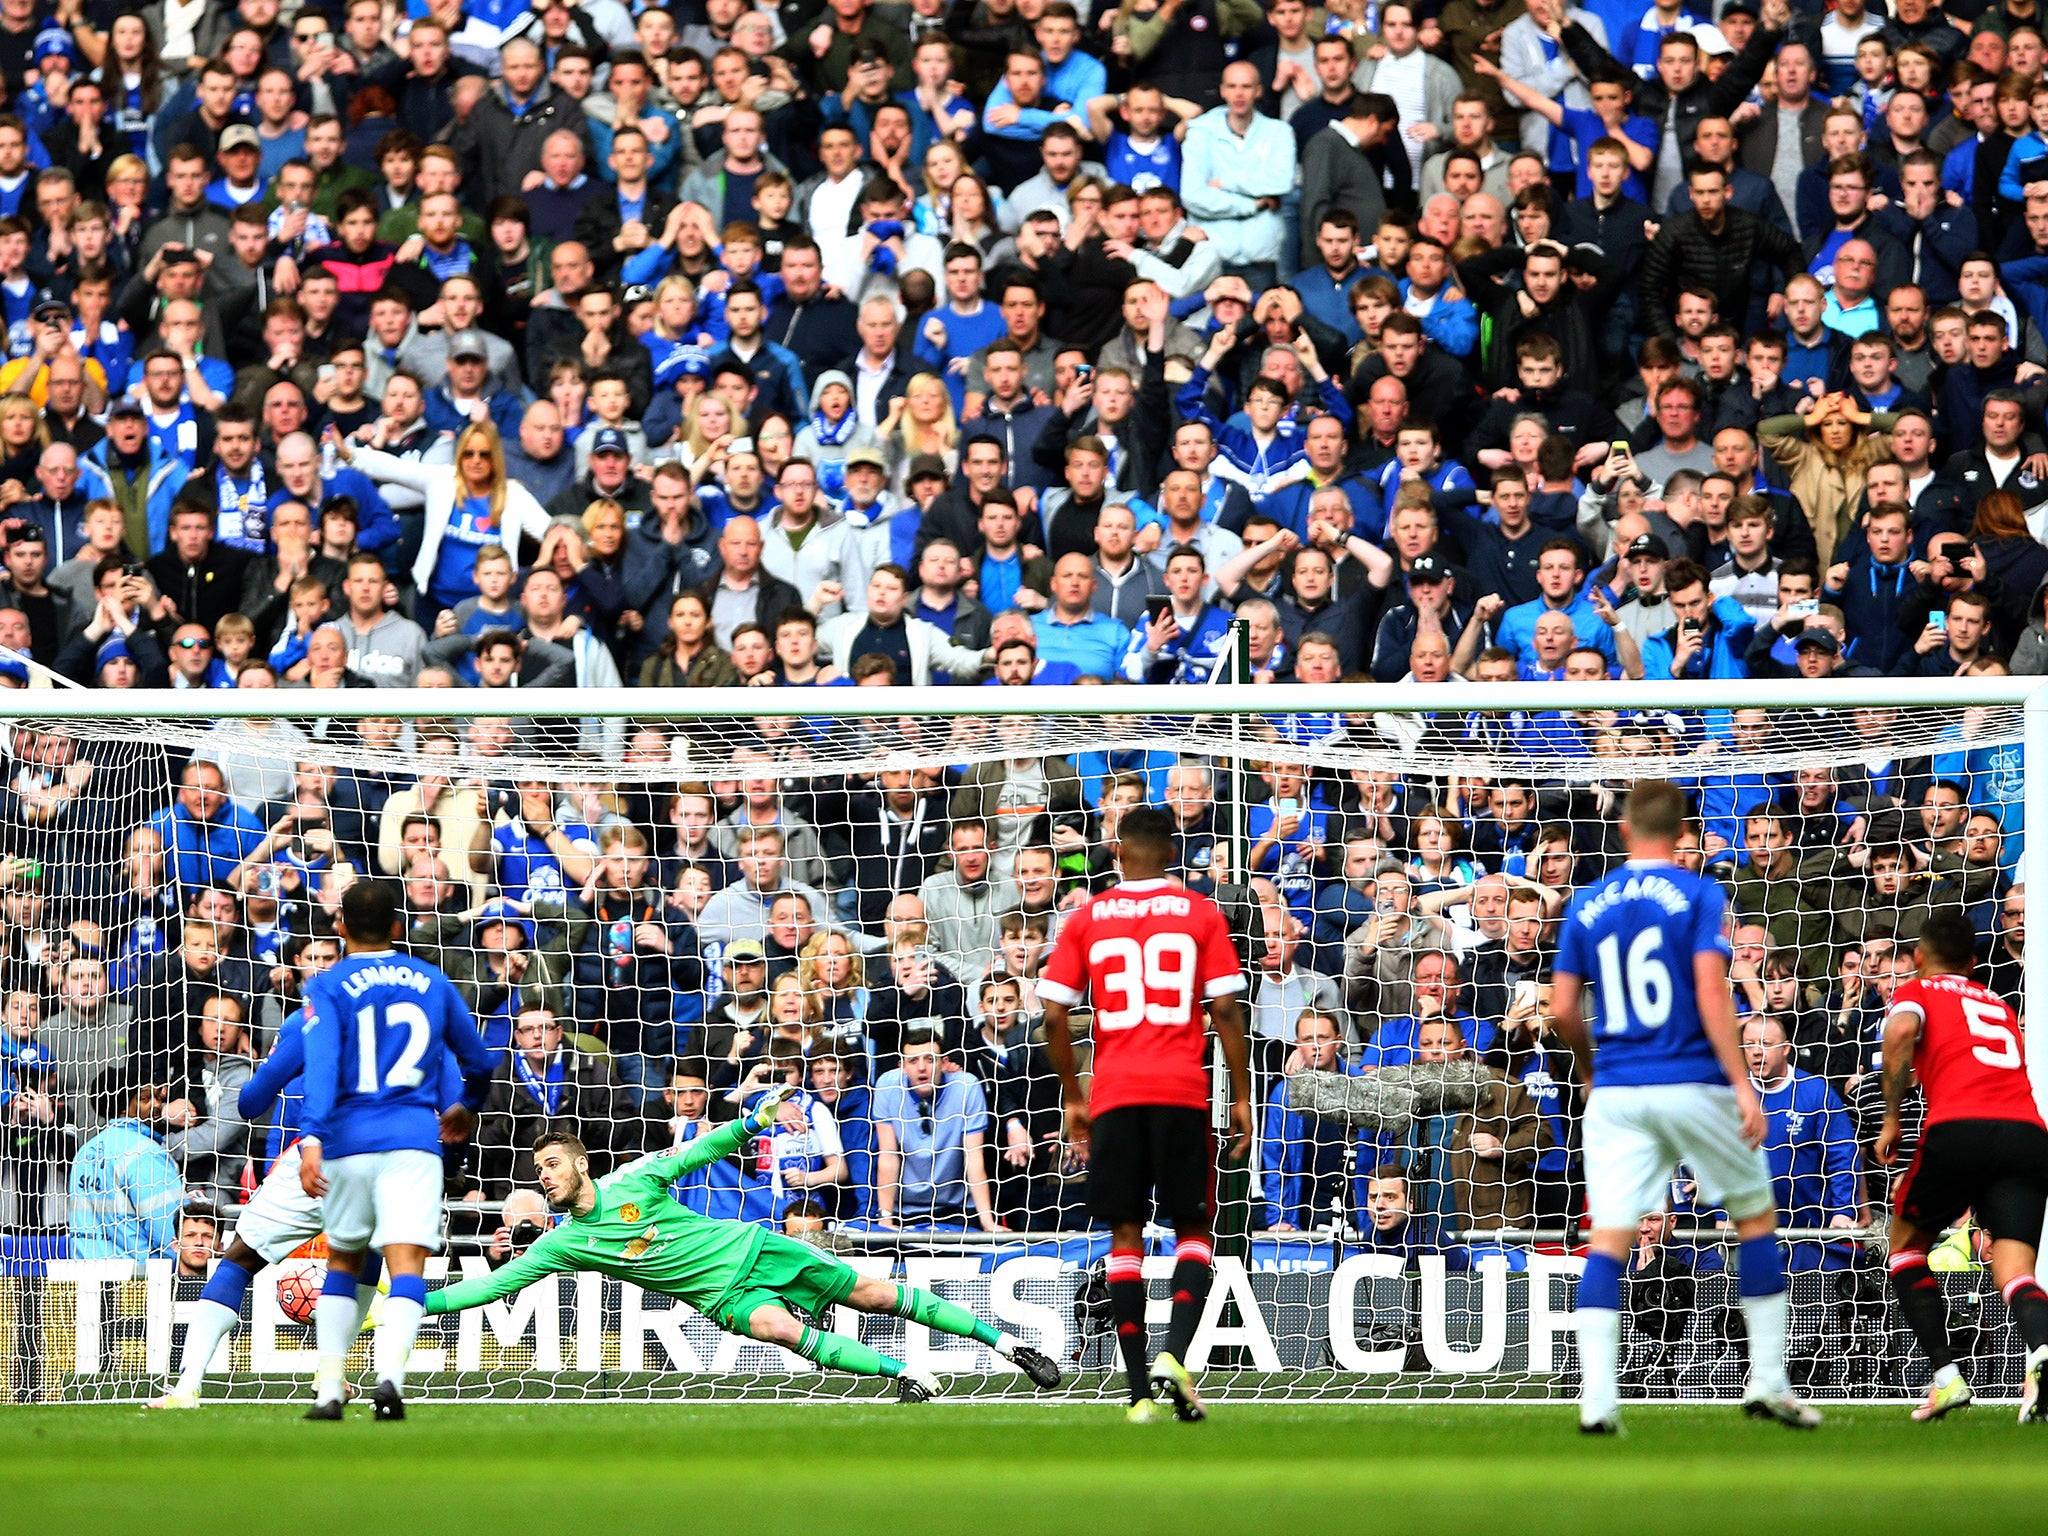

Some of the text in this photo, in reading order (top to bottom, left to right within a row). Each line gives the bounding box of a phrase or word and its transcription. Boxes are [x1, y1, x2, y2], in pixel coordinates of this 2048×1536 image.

[460, 513, 472, 532] I
[1091, 895, 1190, 922] RASHFORD
[341, 965, 434, 999] LENNON
[1089, 931, 1199, 1032] 39
[1596, 924, 1673, 1036] 16
[356, 1001, 433, 1094] 12
[1960, 996, 2022, 1070] 5
[46, 1258, 327, 1373] THE
[1114, 1254, 1283, 1373] FA
